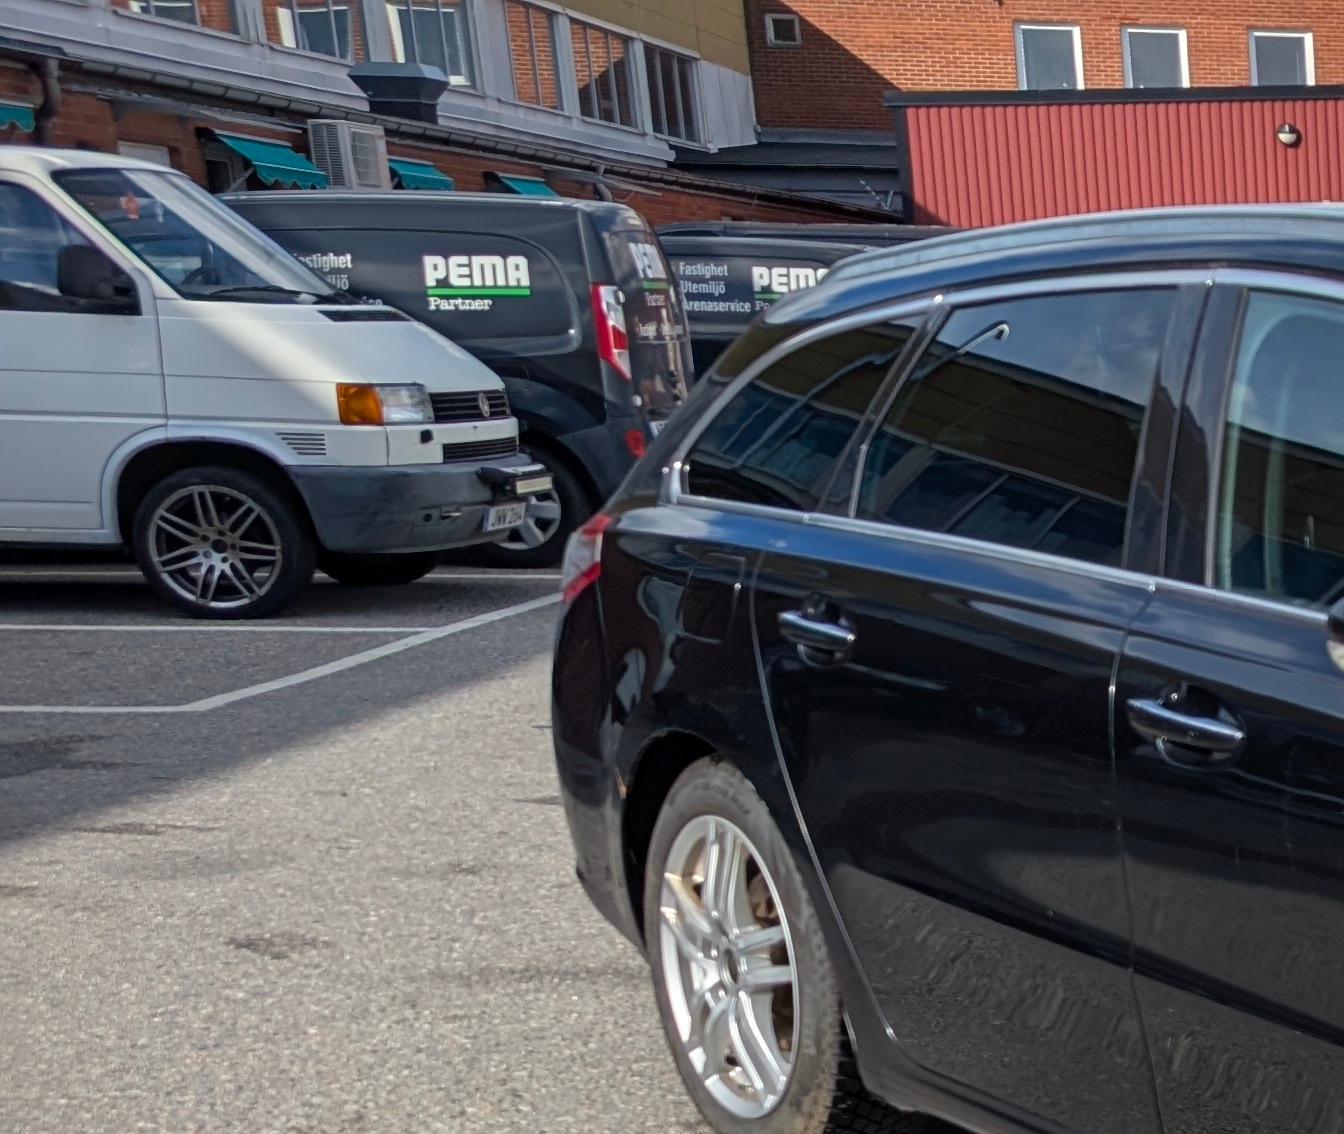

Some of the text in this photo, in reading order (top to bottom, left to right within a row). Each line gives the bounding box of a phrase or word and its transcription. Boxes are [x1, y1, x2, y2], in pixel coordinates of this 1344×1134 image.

[293, 252, 353, 272] stighet
[422, 255, 530, 286] PEMA
[679, 262, 729, 279] Fastighet
[679, 280, 726, 297] Utemiljö
[428, 297, 493, 310] Partner
[684, 300, 752, 312] Arenaservice
